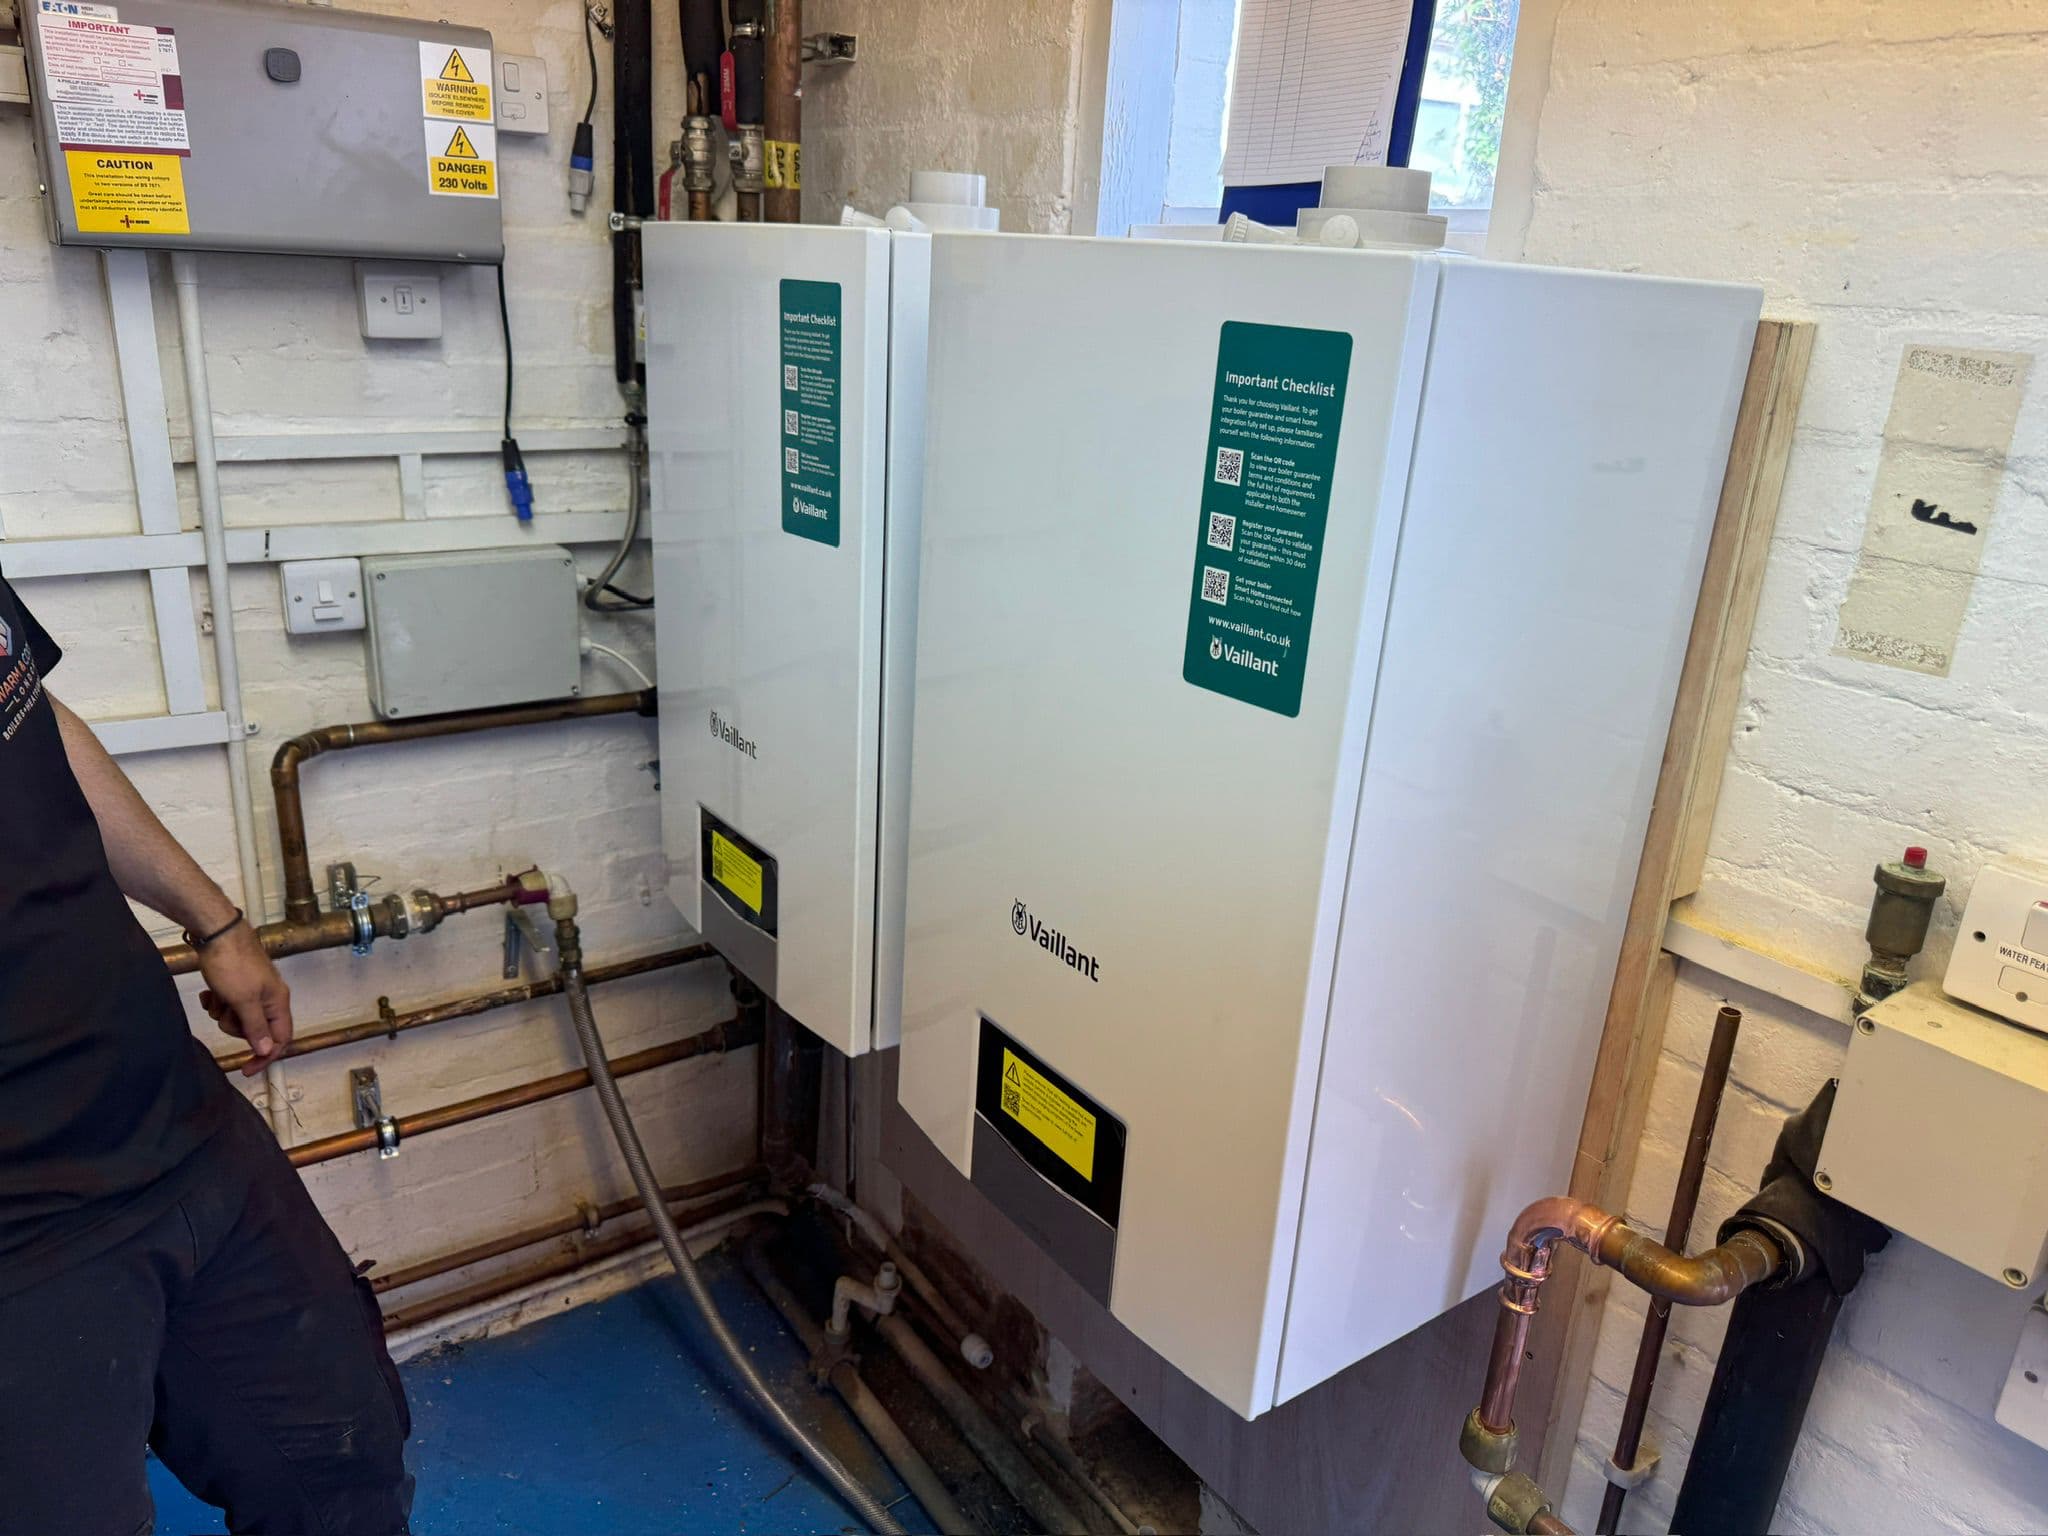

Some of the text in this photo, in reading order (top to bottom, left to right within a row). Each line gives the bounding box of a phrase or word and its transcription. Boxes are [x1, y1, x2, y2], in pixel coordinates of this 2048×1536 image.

[68, 20, 130, 35] IMPORTANT
[437, 83, 477, 95] WARNING
[96, 160, 153, 171] CAUTION
[438, 161, 487, 175] DANGER
[439, 177, 488, 191] 230 Volts
[783, 311, 837, 327] Important Checklist
[1225, 372, 1335, 397] Important Checklist
[1224, 395, 1237, 403] Thank
[1256, 400, 1280, 411] choosing
[1281, 404, 1300, 412] Vaillant.
[1302, 406, 1308, 414] To
[1248, 411, 1273, 419] guarantee
[1302, 418, 1318, 426] home
[1221, 417, 1246, 426] integration
[1247, 420, 1258, 429] fully
[1277, 426, 1294, 434] please
[1295, 428, 1322, 438] familiarise
[1260, 433, 1283, 445] following
[1251, 452, 1263, 461] Scan
[1264, 455, 1273, 463] the
[1248, 471, 1263, 480] terms
[1274, 478, 1301, 487] conditions
[1294, 472, 1320, 481] guarantee
[1246, 491, 1271, 500] applicable
[1272, 494, 1278, 502] to
[1278, 496, 1290, 504] both
[1281, 488, 1315, 499] requirements
[799, 500, 828, 520] Vaillant
[1276, 506, 1306, 517] homeowner
[1242, 520, 1263, 529] Register
[1276, 529, 1303, 538] guarantee
[1254, 531, 1262, 539] the
[1292, 541, 1312, 551] validate
[1252, 542, 1277, 552] guarantee
[1282, 548, 1292, 556] this
[1293, 551, 1306, 559] must
[1244, 558, 1270, 568] installation
[1246, 550, 1268, 559] validated
[1294, 560, 1306, 568] days
[1257, 581, 1272, 590] boiler
[1235, 584, 1292, 605] Smart Home connected
[1270, 603, 1280, 611] find
[1208, 617, 1291, 647] www.vaillant.co.uk
[1224, 645, 1278, 676] Vaillant
[719, 718, 758, 760] Vaillant
[1030, 914, 1100, 983] Vaillant
[1999, 946, 2028, 964] WATER
